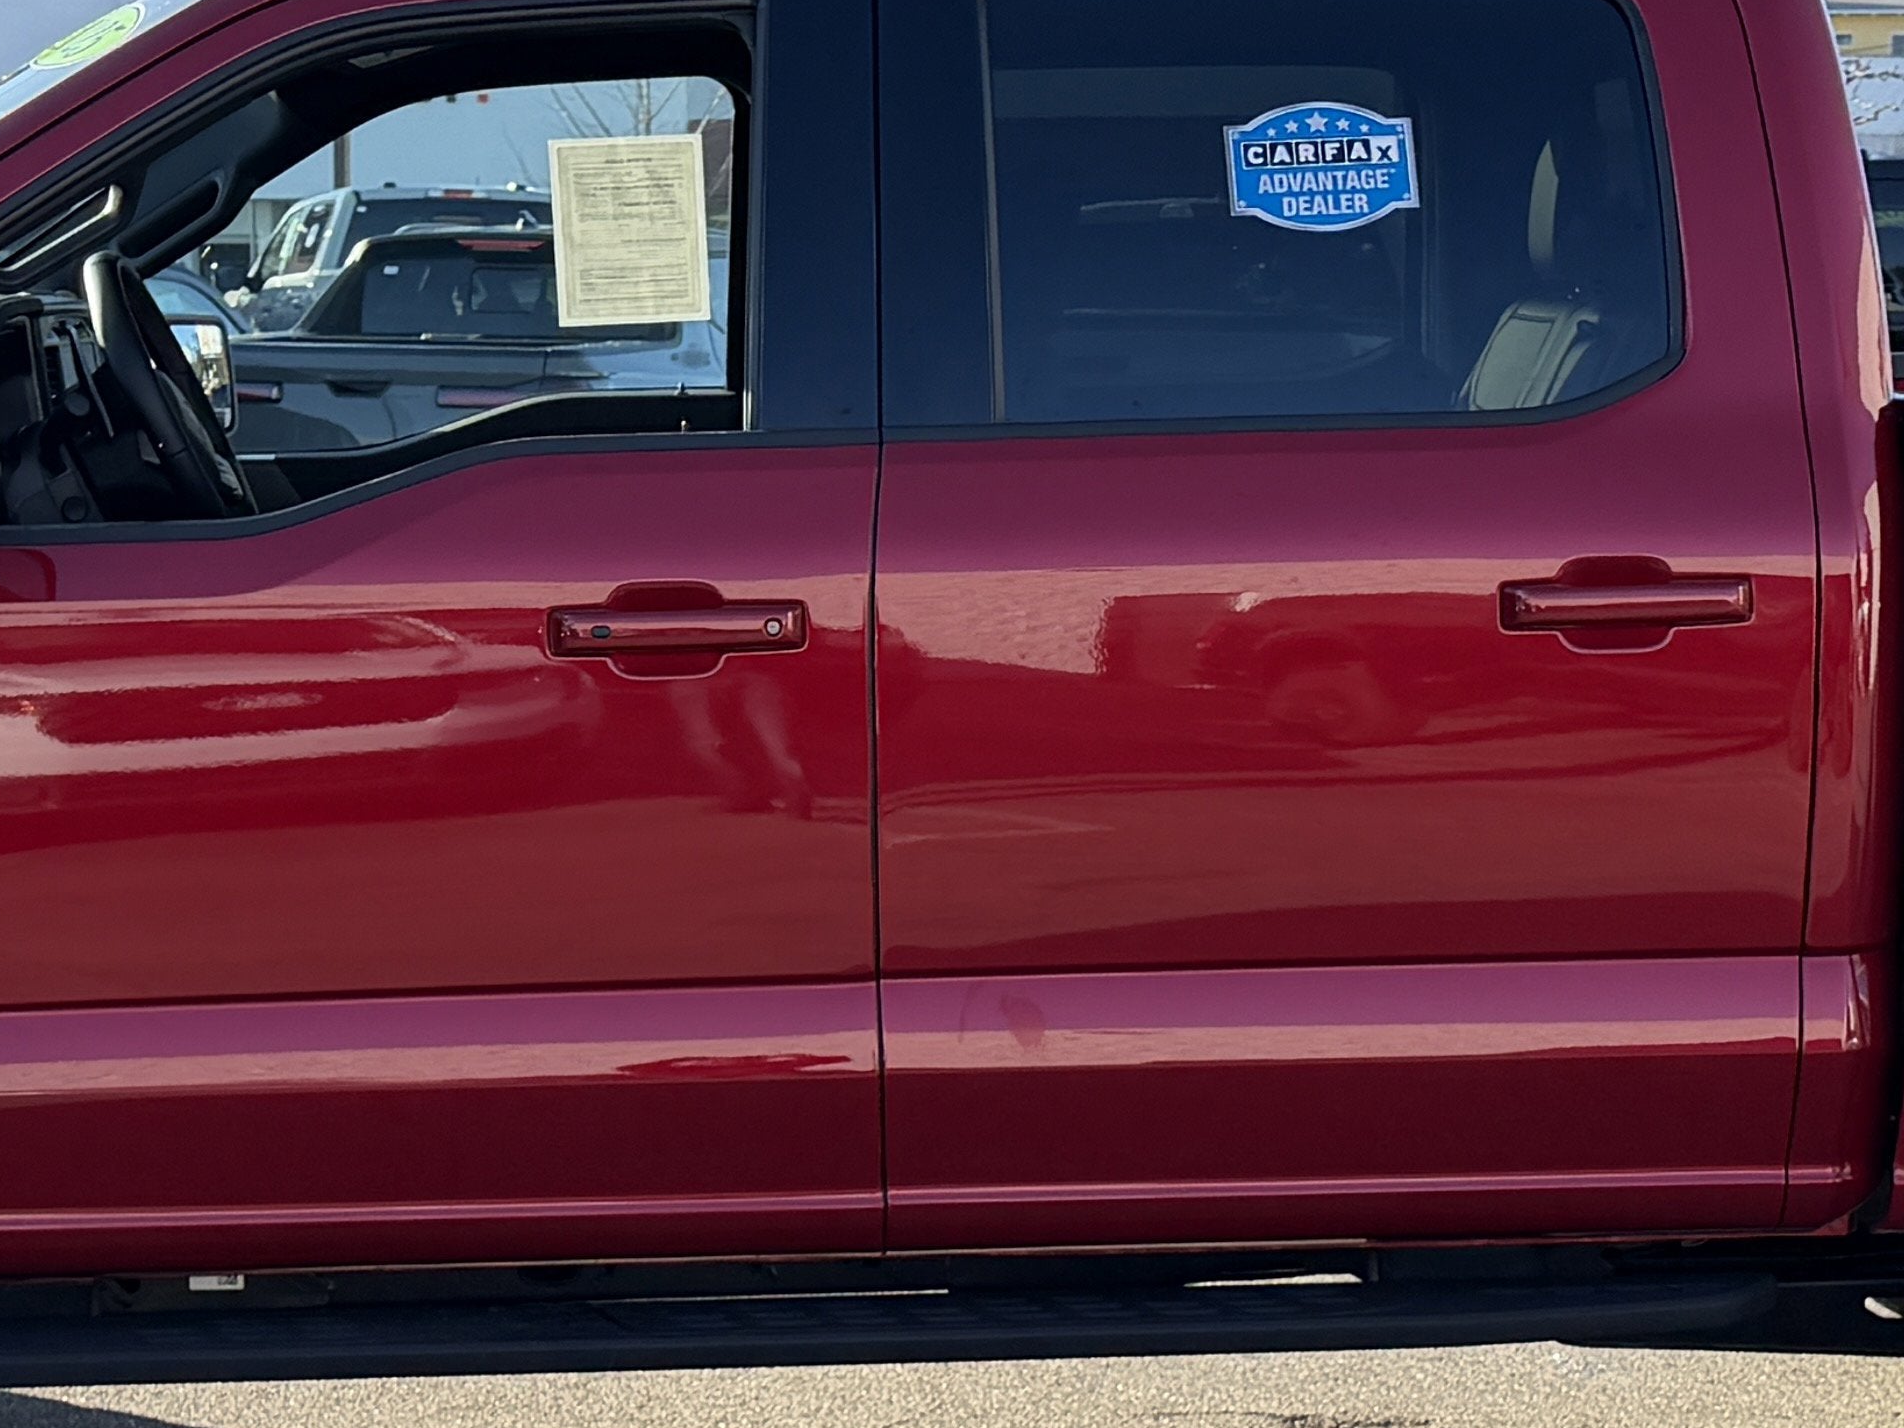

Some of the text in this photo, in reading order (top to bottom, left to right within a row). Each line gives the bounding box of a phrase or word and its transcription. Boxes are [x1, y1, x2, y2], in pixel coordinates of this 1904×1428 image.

[1246, 140, 1393, 166] CARFAX
[1258, 170, 1390, 194] ADVANTAGE
[1282, 193, 1369, 217] DEALER
